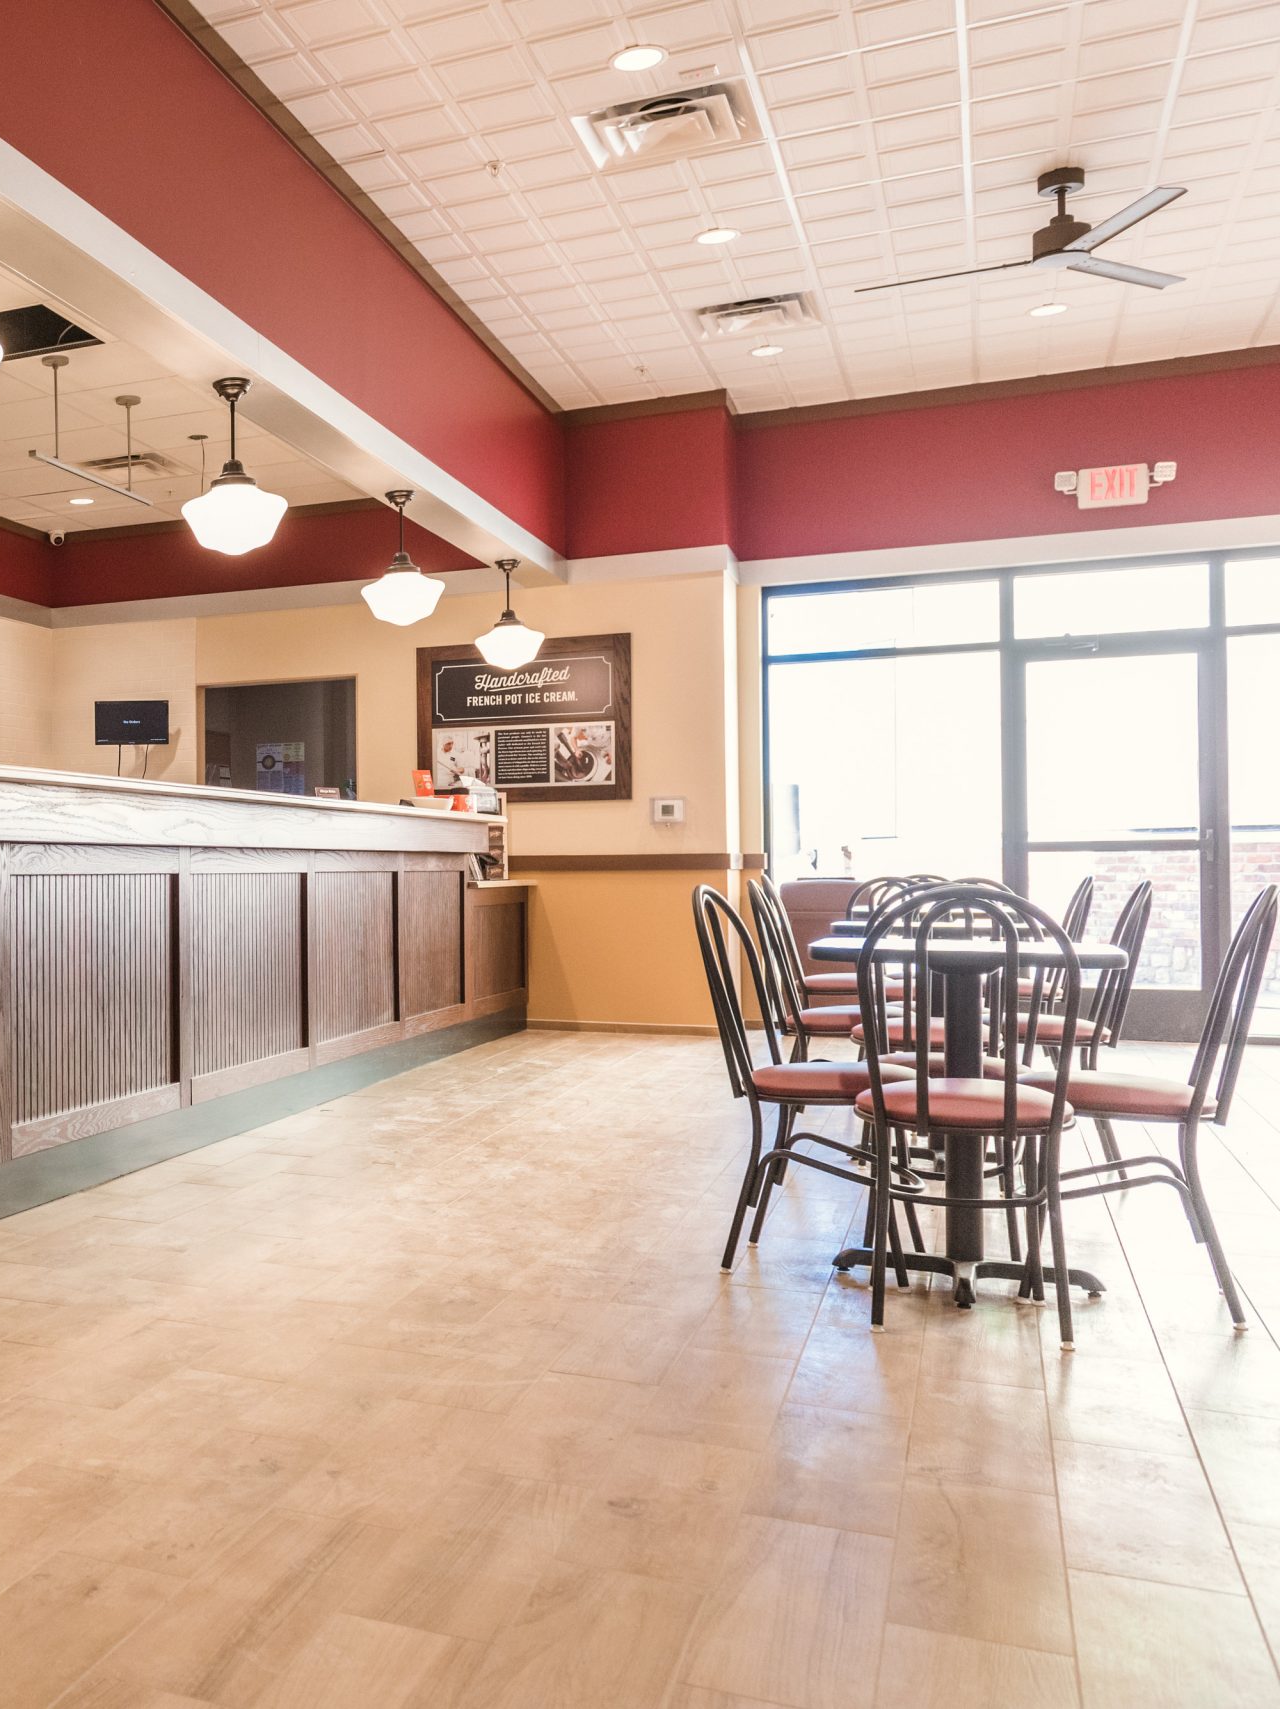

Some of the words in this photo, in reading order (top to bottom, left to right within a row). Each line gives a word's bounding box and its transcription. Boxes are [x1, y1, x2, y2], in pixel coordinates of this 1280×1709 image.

[1090, 467, 1138, 501] EXIT
[474, 666, 570, 691] Handcrafted
[466, 694, 502, 707] FRENCH
[504, 694, 522, 705] POT
[525, 693, 540, 704] ICE
[543, 691, 578, 703] CREAM.
